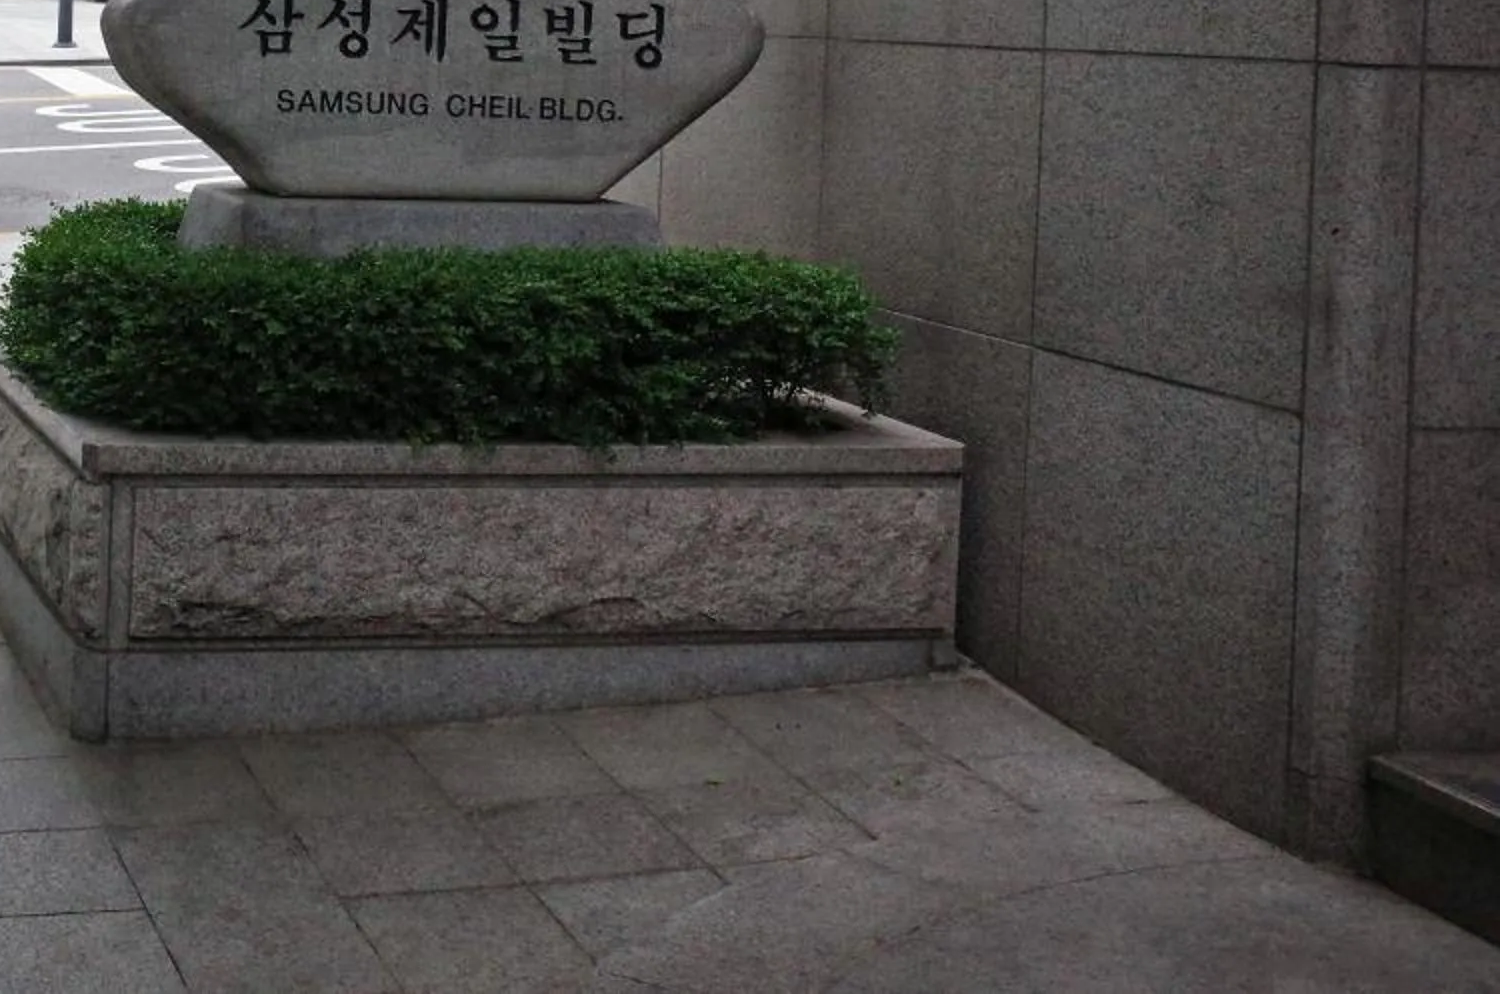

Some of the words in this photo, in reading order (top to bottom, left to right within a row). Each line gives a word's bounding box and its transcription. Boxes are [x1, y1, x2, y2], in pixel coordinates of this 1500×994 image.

[275, 88, 429, 117] SAMSUNG
[445, 92, 531, 121] CHEIL
[538, 94, 625, 123] BLDG.
